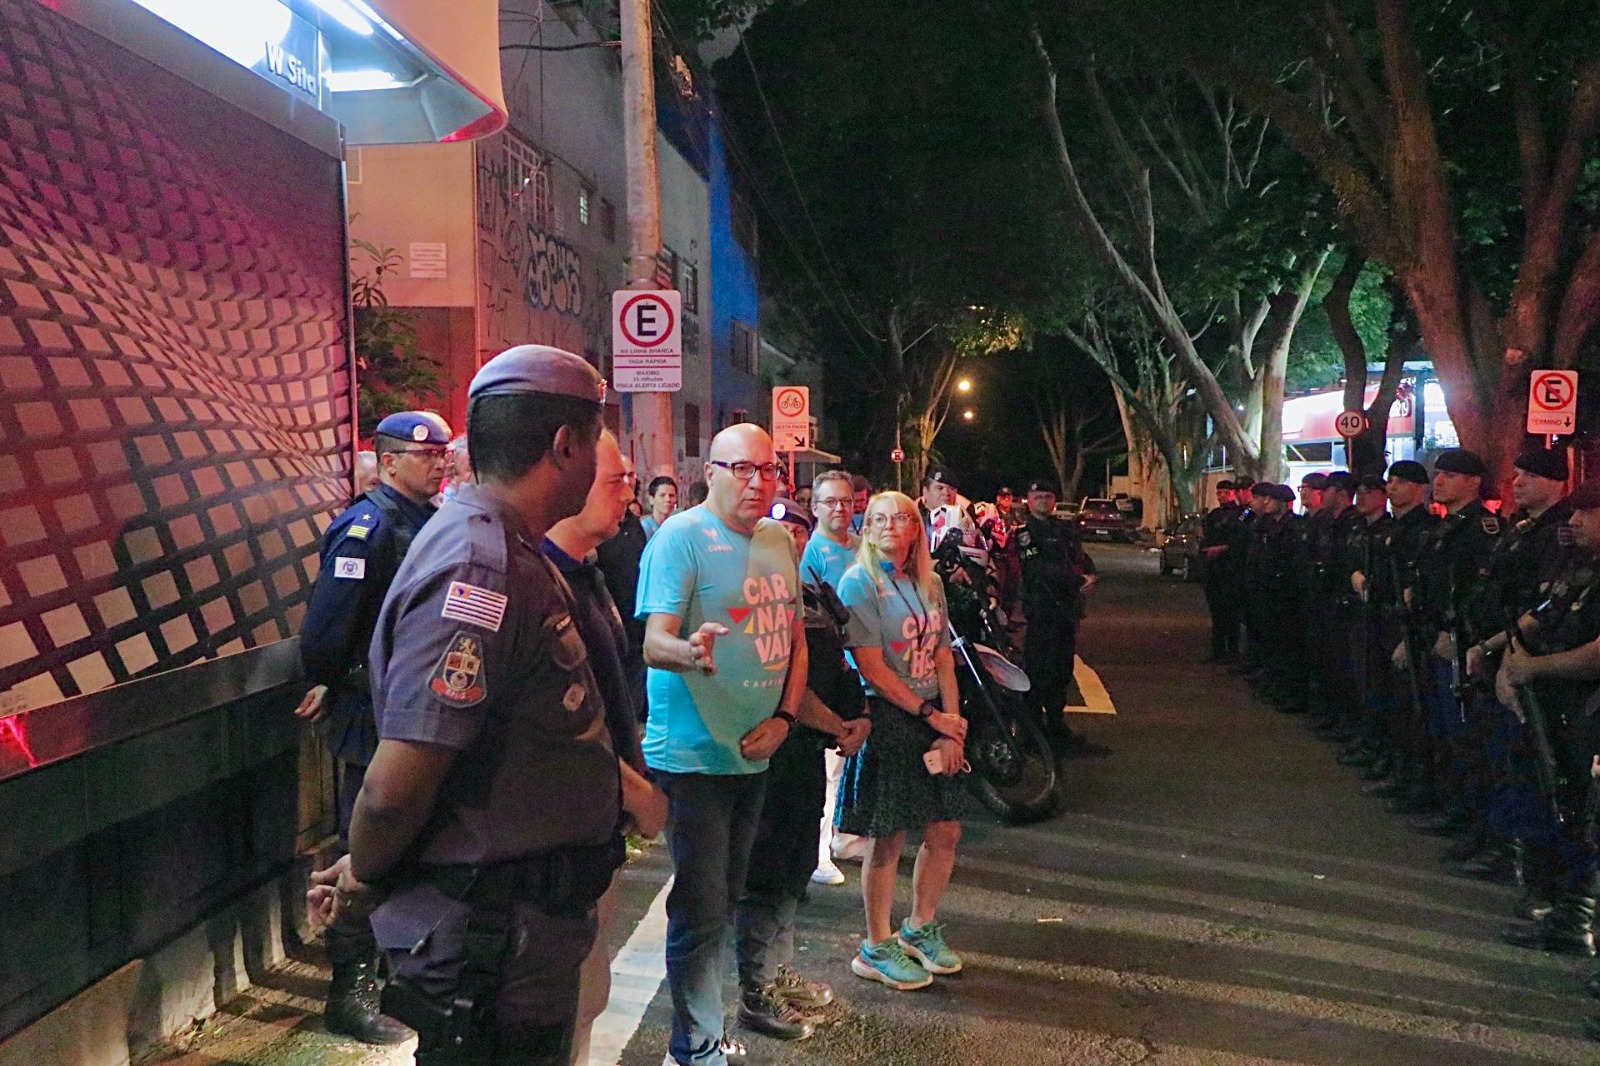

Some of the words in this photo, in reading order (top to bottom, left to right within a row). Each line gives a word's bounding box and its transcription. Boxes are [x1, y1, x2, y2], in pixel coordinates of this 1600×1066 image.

[265, 40, 284, 76] W
[637, 305, 657, 336] E
[1545, 380, 1562, 402] E
[1340, 416, 1360, 429] 40
[743, 572, 789, 605] CAR
[757, 603, 788, 635] NA
